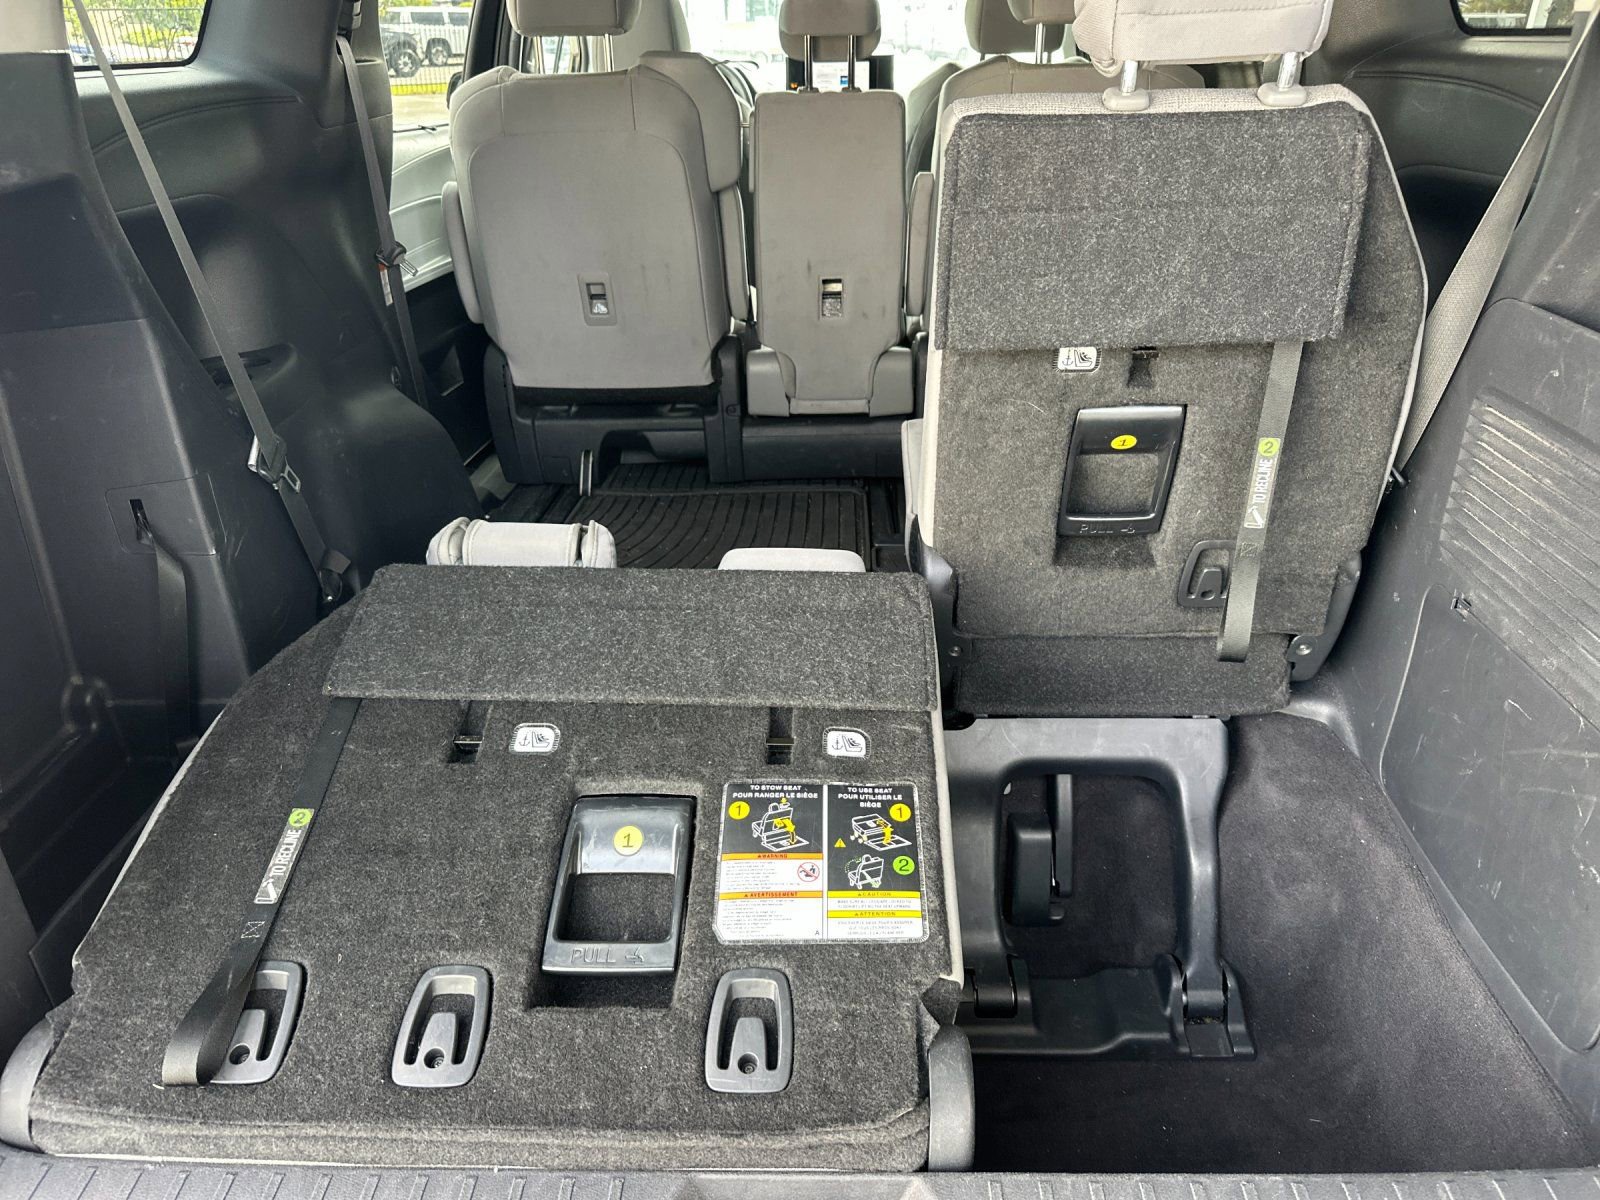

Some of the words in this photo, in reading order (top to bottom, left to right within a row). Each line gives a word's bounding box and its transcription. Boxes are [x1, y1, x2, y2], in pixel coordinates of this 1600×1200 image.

[1263, 441, 1274, 454] 2
[1254, 458, 1273, 493] RECLINE
[1252, 493, 1266, 504] TO
[294, 811, 306, 824] 2
[275, 829, 302, 865] RECLINE
[621, 833, 634, 848] 1
[269, 865, 286, 878] TO
[898, 858, 910, 872] 2
[571, 947, 617, 963] PULL
